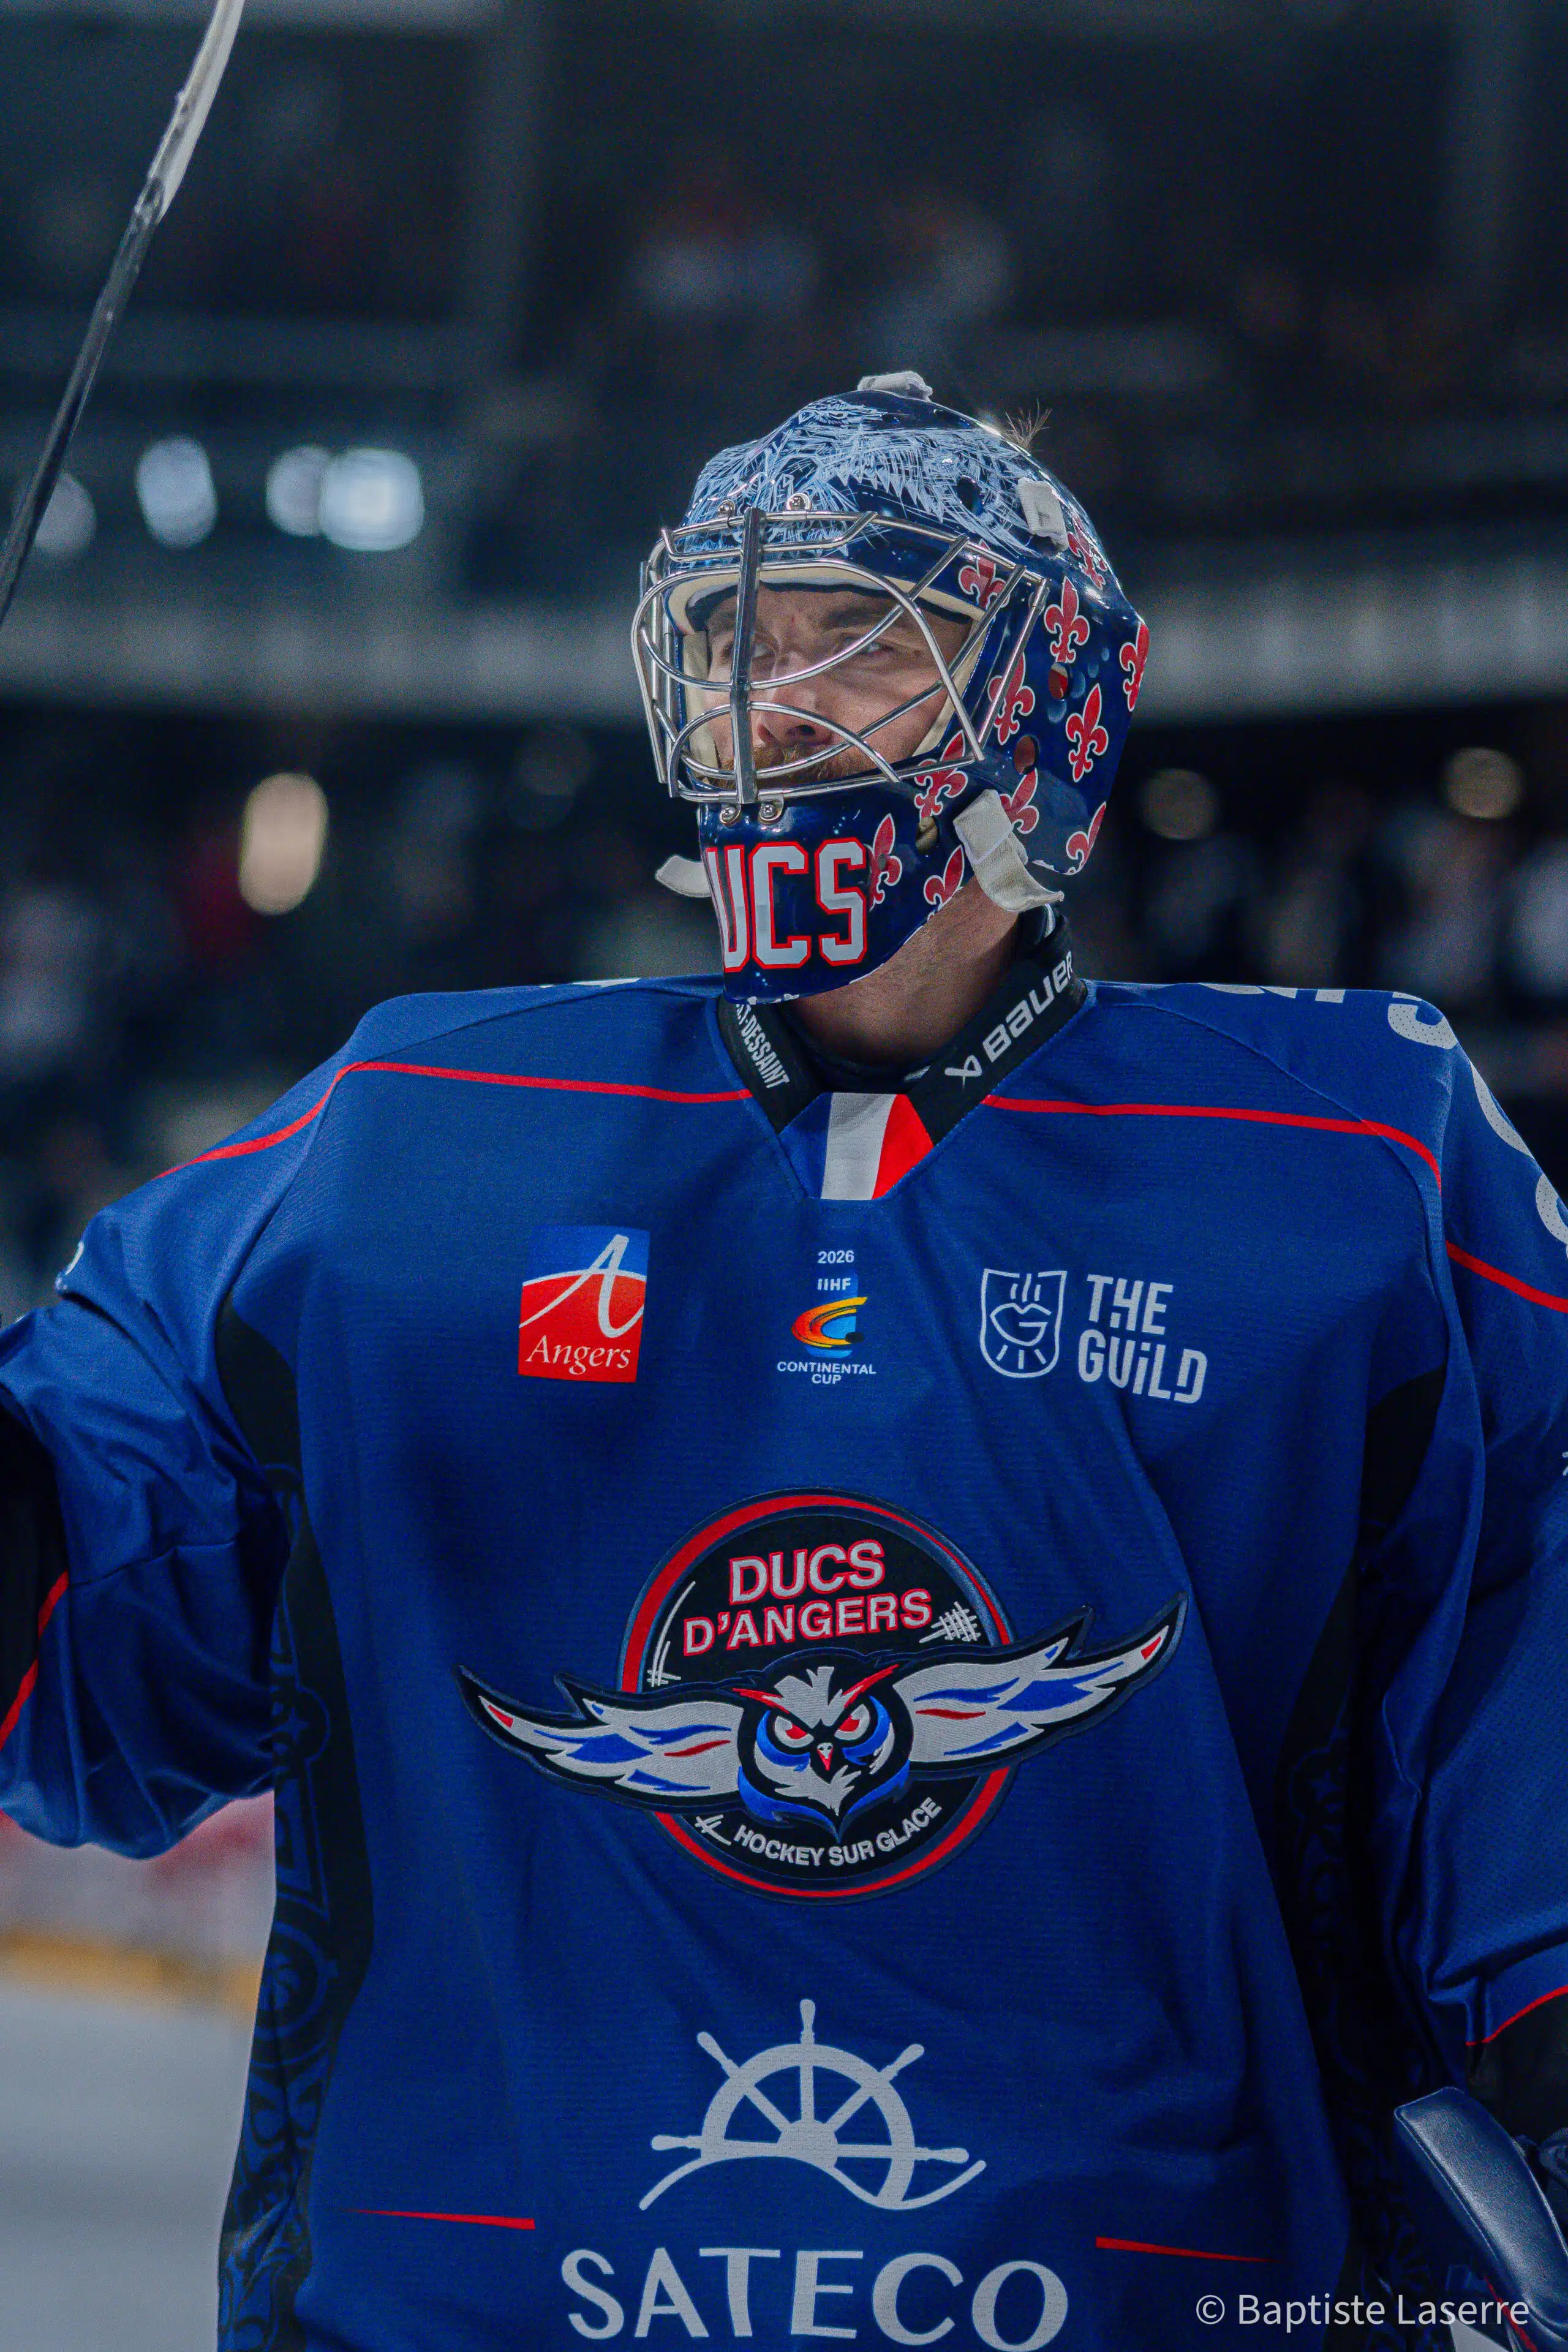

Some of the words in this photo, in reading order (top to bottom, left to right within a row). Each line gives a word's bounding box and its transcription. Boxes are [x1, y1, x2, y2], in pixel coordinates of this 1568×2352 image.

[818, 1250, 854, 1264] 2026
[817, 1278, 851, 1291] IIHF
[1087, 1274, 1174, 1335] THE
[526, 1335, 631, 1375] Angers
[777, 1361, 876, 1374] CONTINENTAL
[812, 1374, 842, 1384] CUP
[729, 1539, 885, 1605] DUCS
[684, 1588, 932, 1656] D'ANGERS
[733, 1824, 824, 1866] HOCKEY
[829, 1840, 875, 1866] SUR
[876, 1796, 942, 1852] GLACE
[561, 2247, 1068, 2352] SATECO
